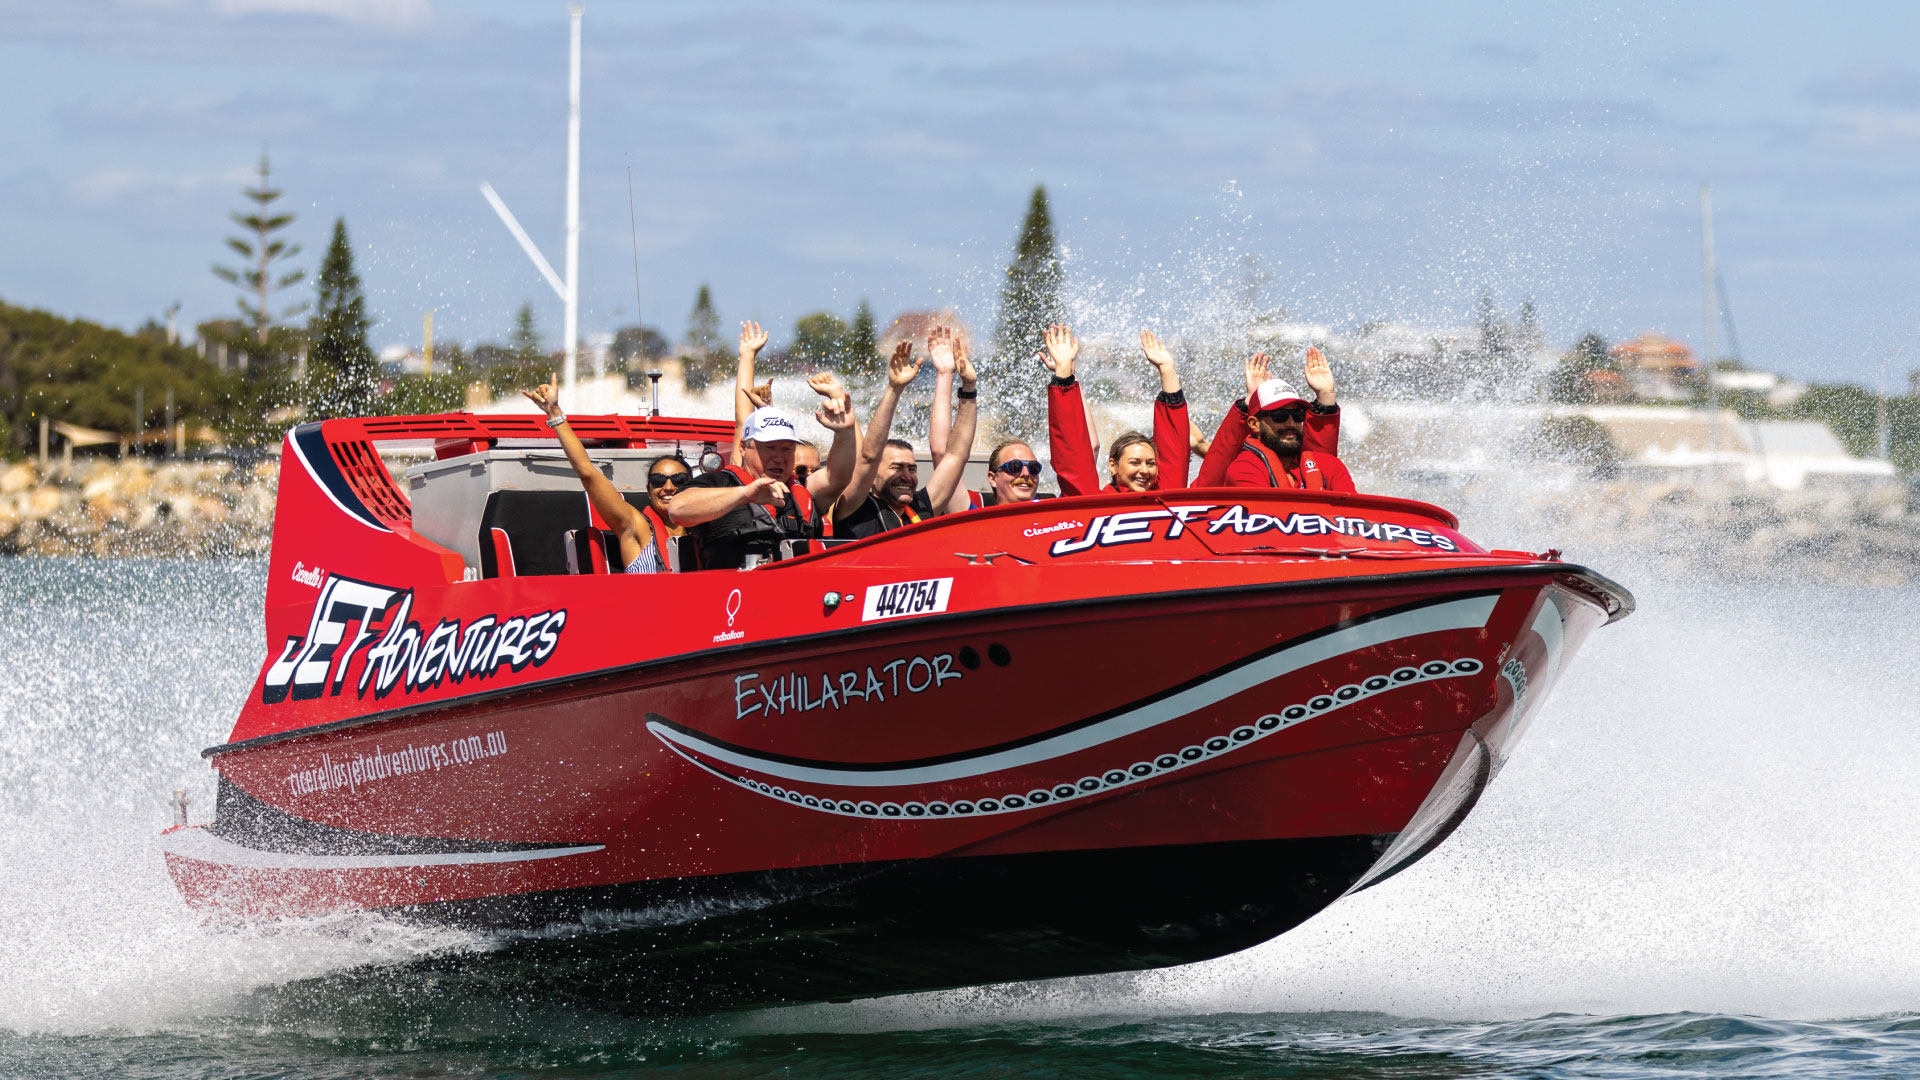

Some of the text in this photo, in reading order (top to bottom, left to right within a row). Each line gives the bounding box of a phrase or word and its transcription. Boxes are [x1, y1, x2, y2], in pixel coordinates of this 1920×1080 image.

[1023, 519, 1084, 537] Cicerello's
[1049, 505, 1211, 557] JET
[876, 580, 940, 616] 442754
[263, 573, 413, 704] JET
[713, 630, 745, 643] redballoon
[734, 654, 962, 720] EXHILARATOR
[290, 730, 508, 797] cicerellosjetadventures.com.au
